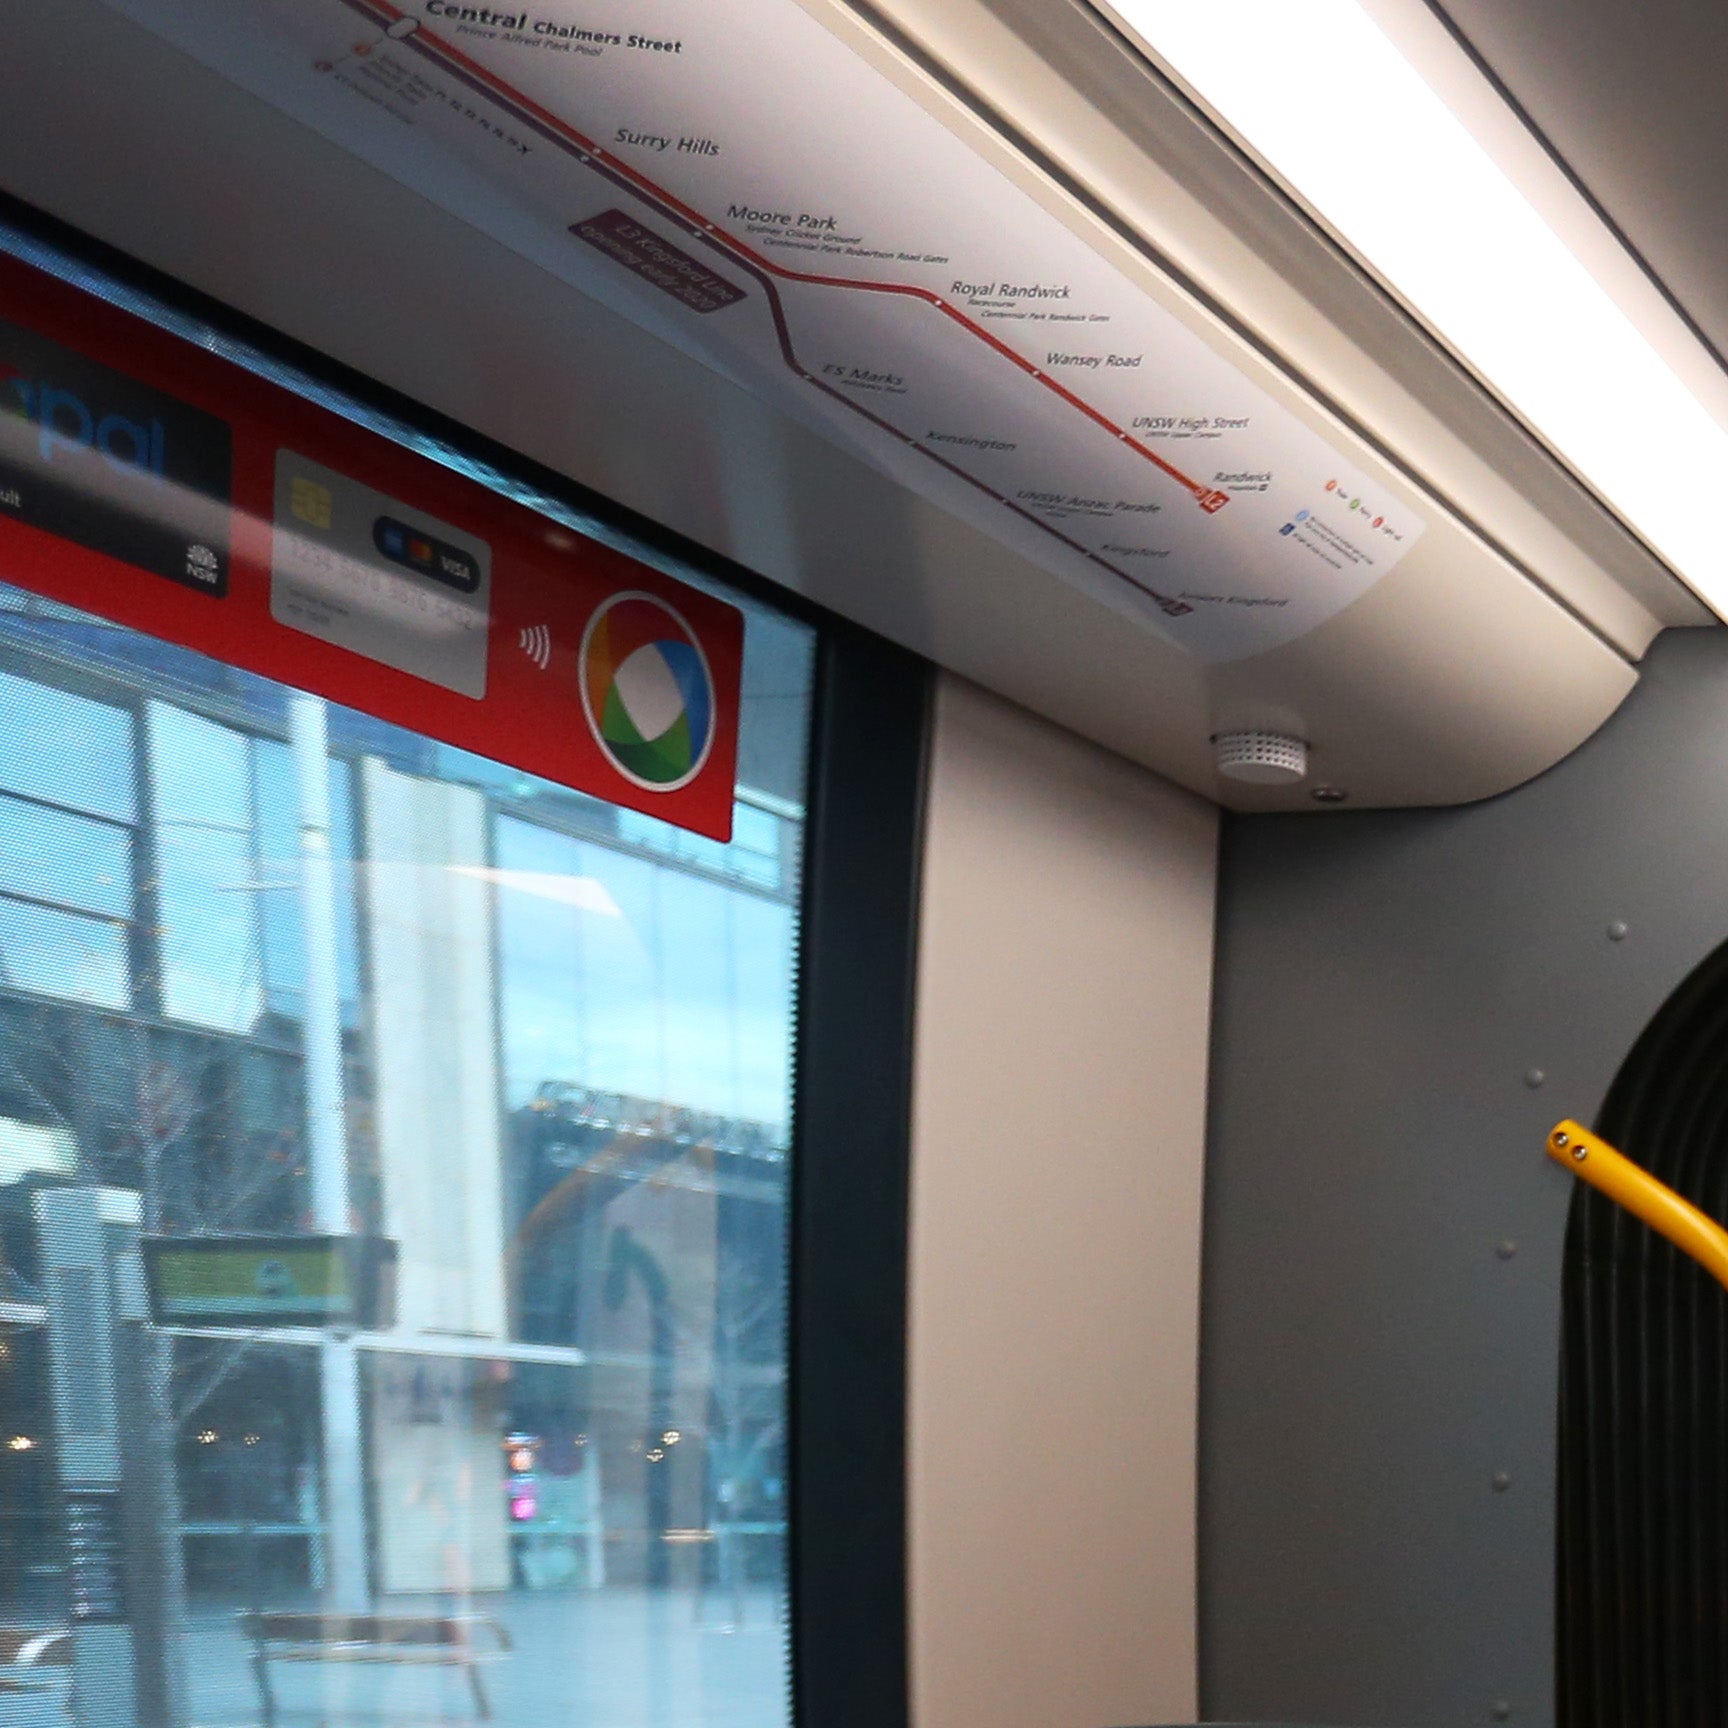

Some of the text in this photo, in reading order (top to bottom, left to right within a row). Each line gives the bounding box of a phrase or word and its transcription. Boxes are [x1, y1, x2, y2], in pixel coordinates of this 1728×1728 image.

[427, 0, 683, 54] Central Chalmers Street
[615, 128, 720, 157] Surry Hills
[727, 204, 838, 231] Moore Park
[950, 281, 1072, 300] Royal Randwick
[1046, 352, 1144, 369] Wansey Road
[850, 368, 904, 386] Marks
[1132, 416, 1250, 432] UNSW High Street
[926, 430, 1018, 452] Kensington
[1213, 471, 1273, 483] Randwick
[186, 562, 219, 585] NSW
